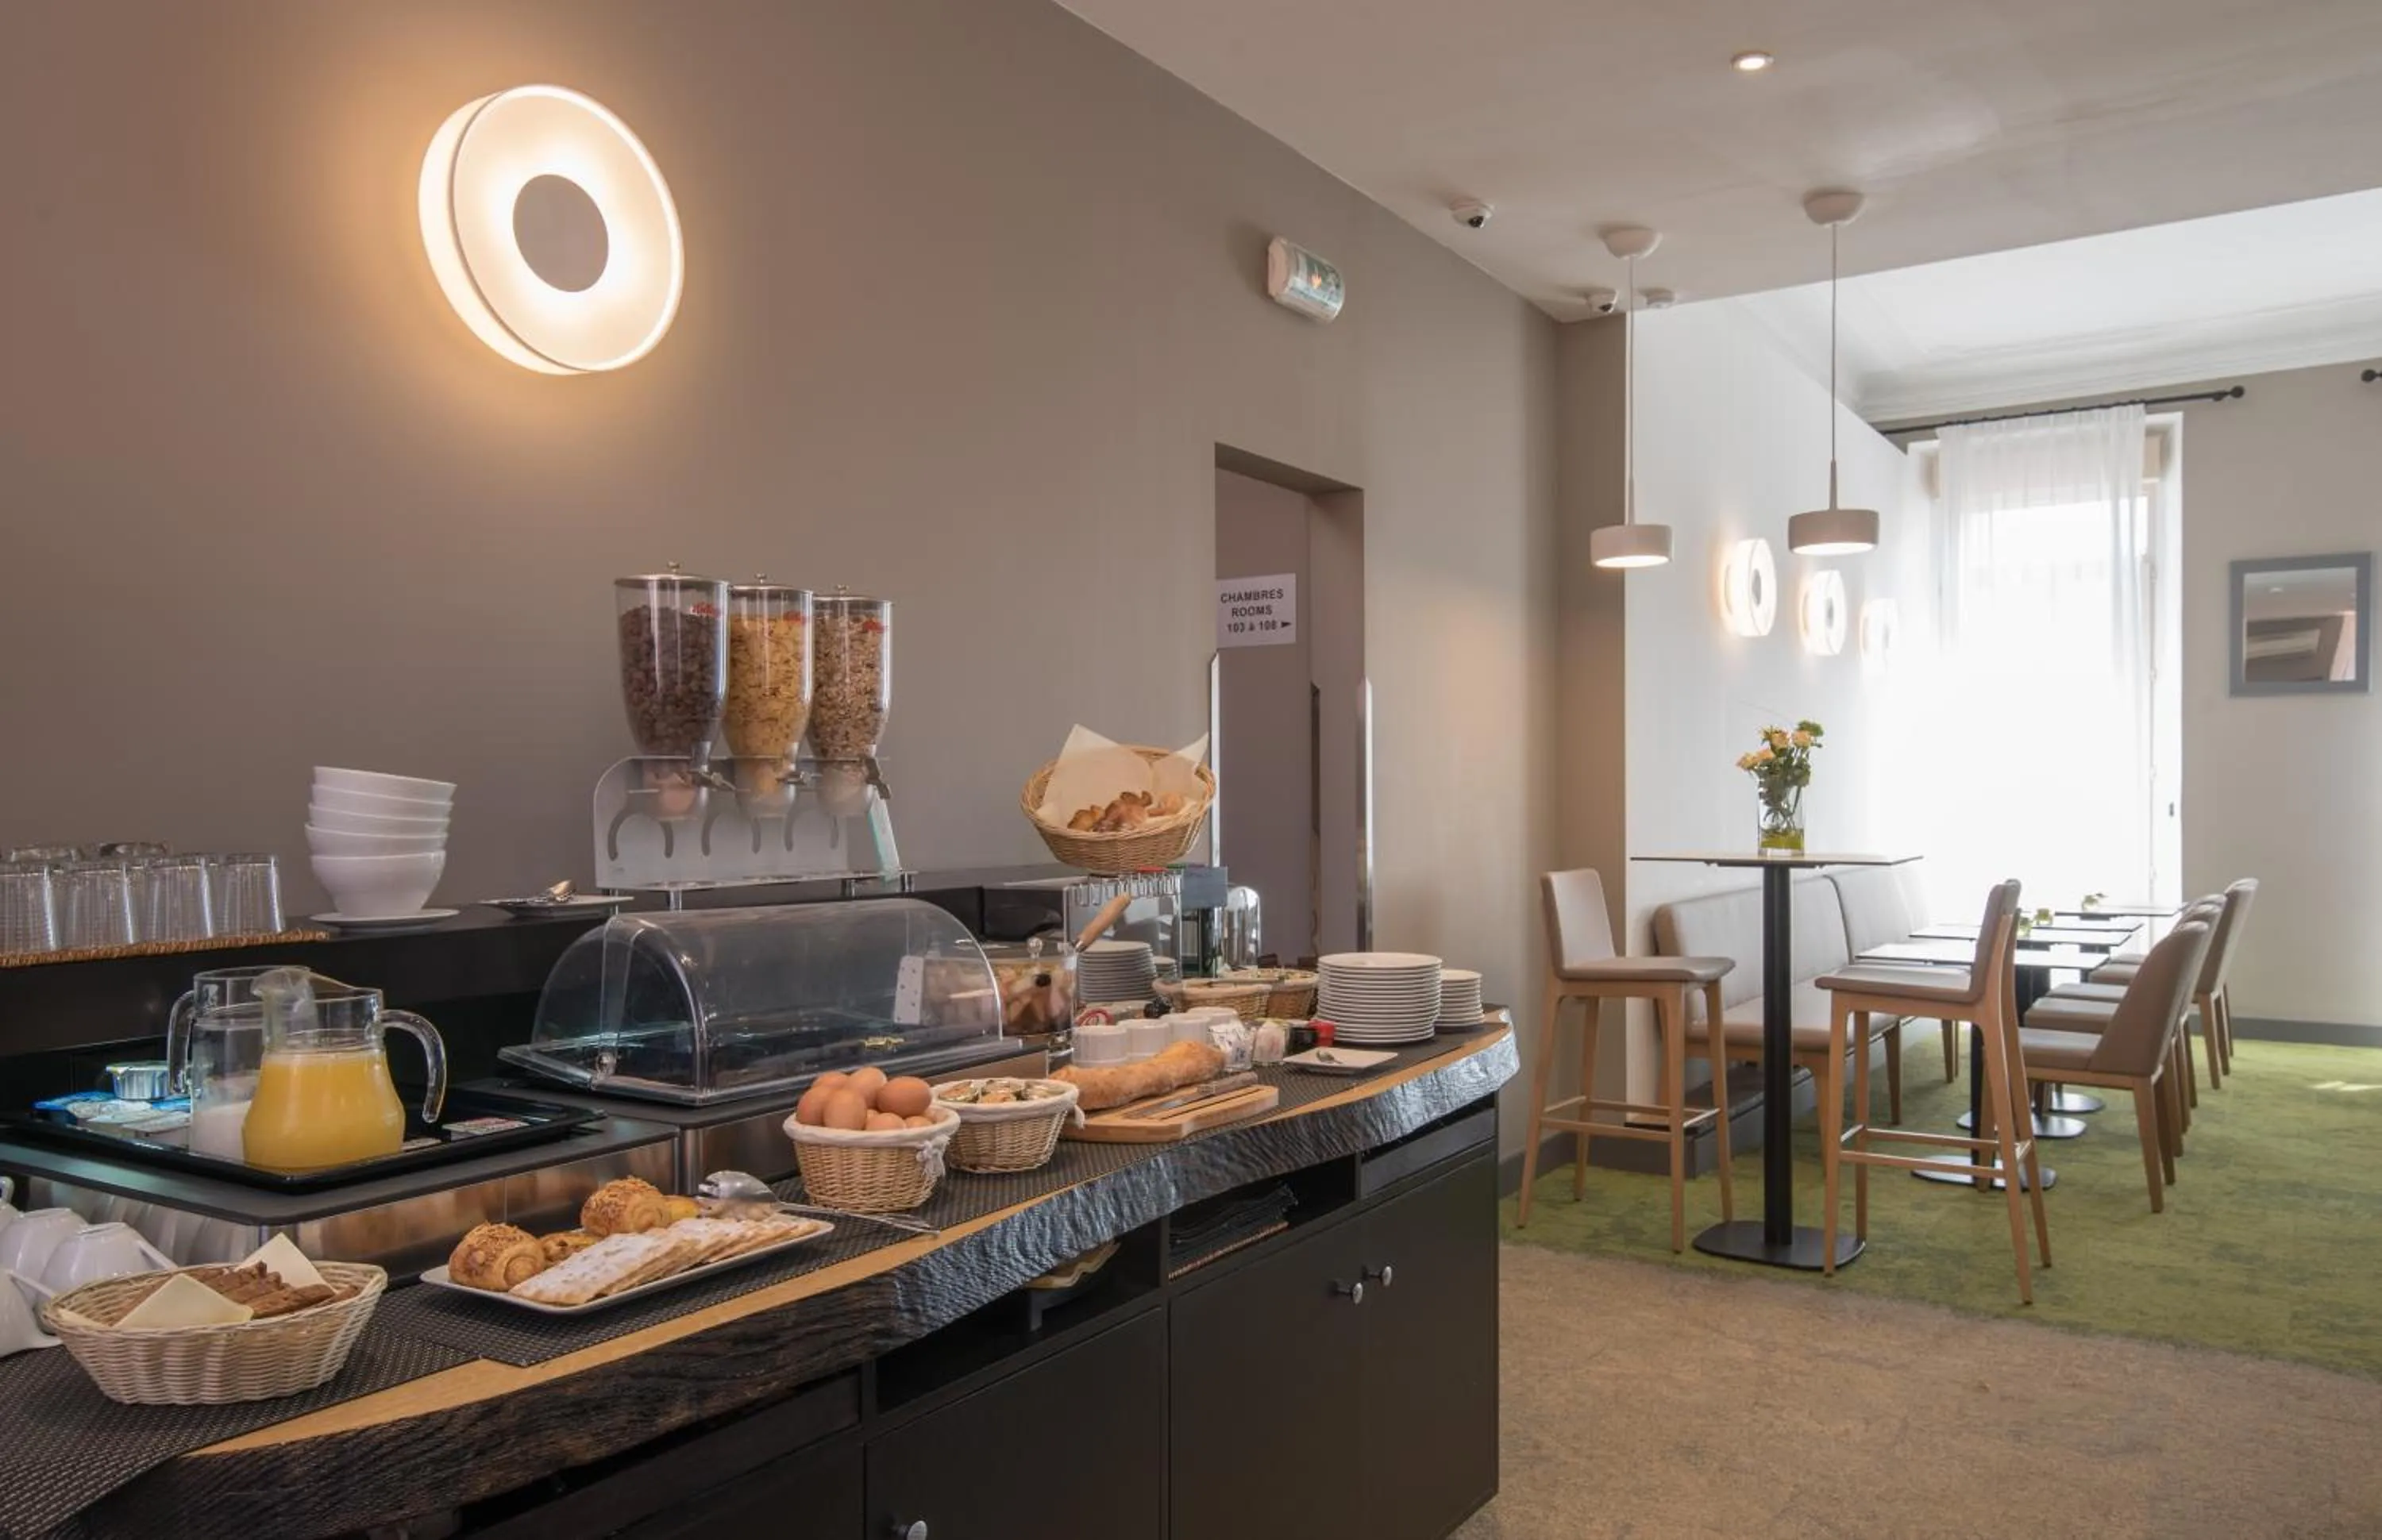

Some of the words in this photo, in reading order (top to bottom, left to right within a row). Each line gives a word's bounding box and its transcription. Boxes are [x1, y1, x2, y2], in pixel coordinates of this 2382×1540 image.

[1220, 588, 1284, 603] CHAMBRES
[1231, 605, 1273, 618] ROOMS
[1227, 622, 1245, 633] 103
